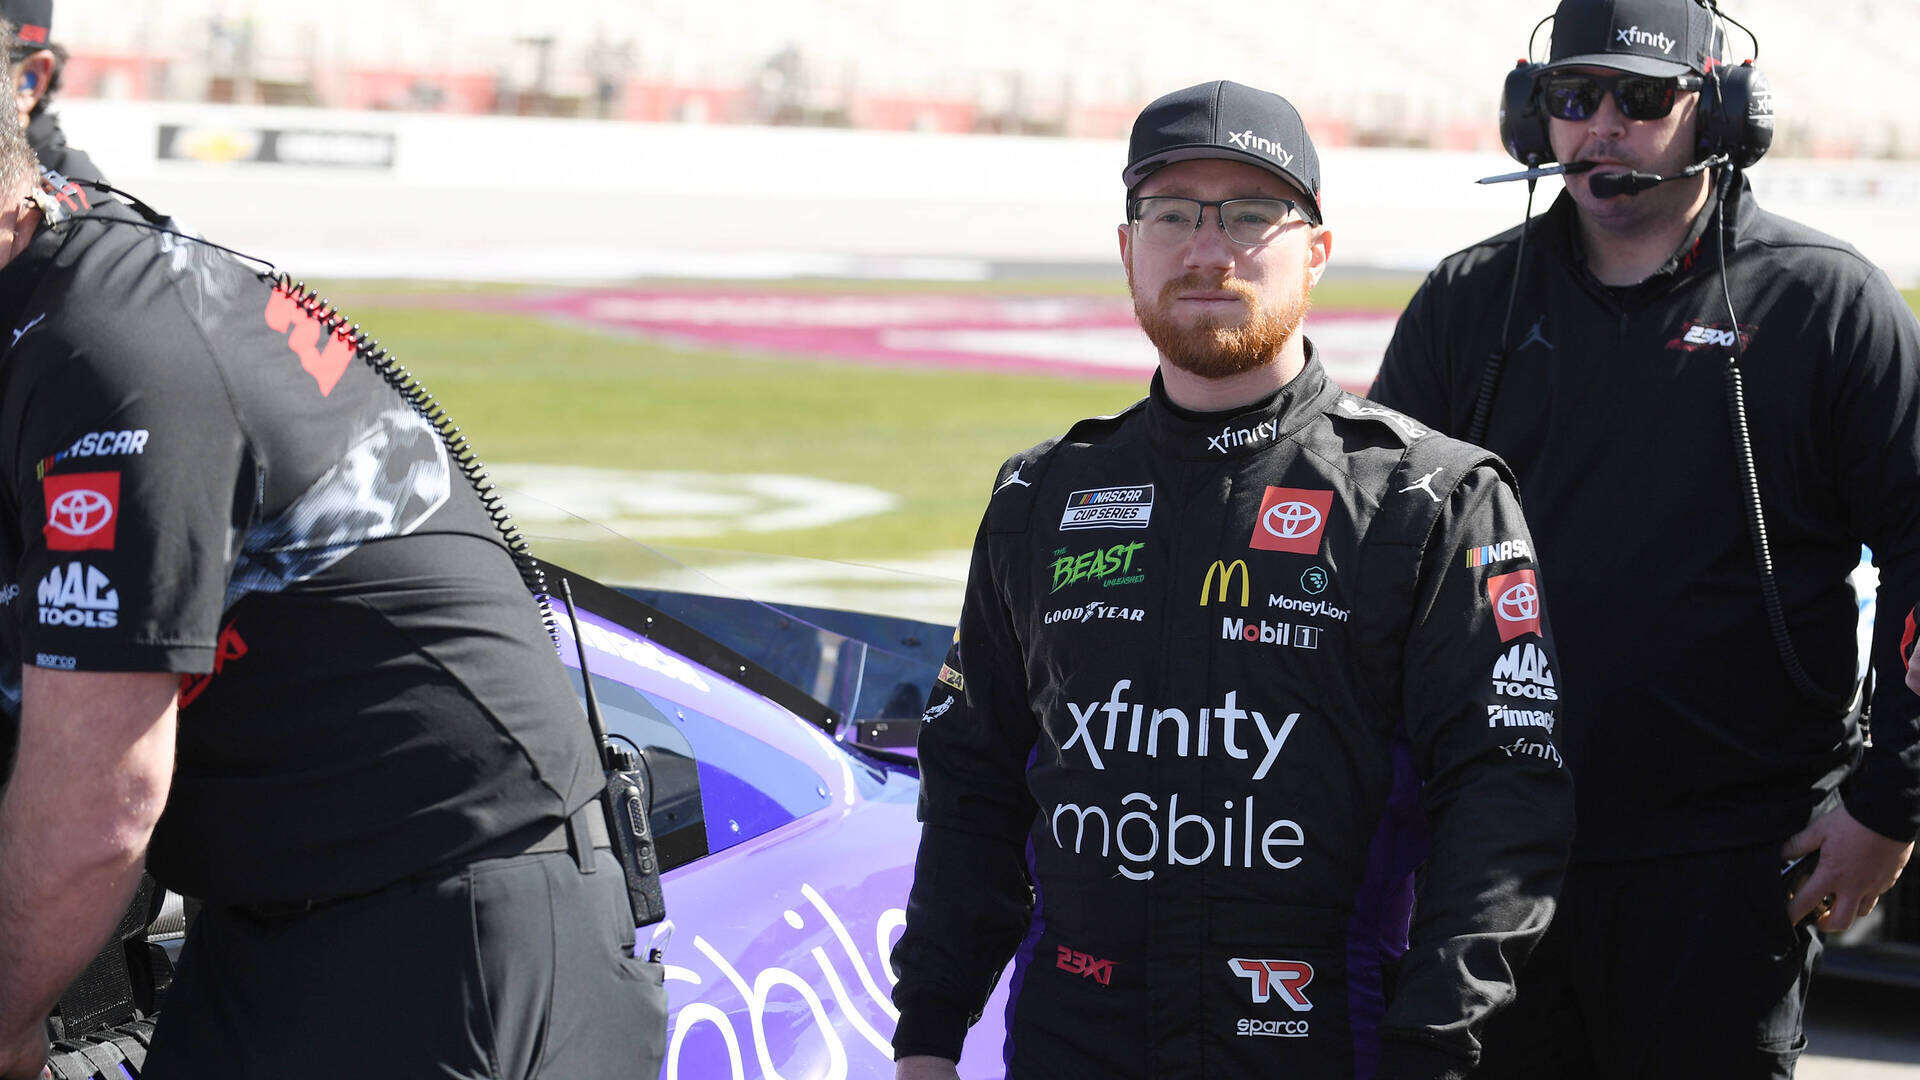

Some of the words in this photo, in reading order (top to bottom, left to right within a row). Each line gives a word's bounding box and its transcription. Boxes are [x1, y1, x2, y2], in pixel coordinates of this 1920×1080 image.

[1616, 26, 1675, 54] xfinity
[1228, 130, 1295, 168] xfinity
[1207, 418, 1278, 454] xfinity
[1093, 489, 1143, 504] NASCAR
[1073, 509, 1098, 521] CUP
[1097, 507, 1140, 519] SERIES
[1053, 547, 1068, 556] THE
[1049, 540, 1146, 595] BEAST
[1103, 574, 1145, 588] UNLEASHED
[37, 560, 119, 610] MAC
[38, 606, 118, 628] TOOLS
[1268, 593, 1348, 623] MoneyLion
[1222, 616, 1290, 646] Mobil
[1492, 642, 1555, 687] MAC
[1492, 680, 1558, 701] TOOLS
[1060, 678, 1300, 780] xfinity
[1236, 1016, 1309, 1038] sparco
